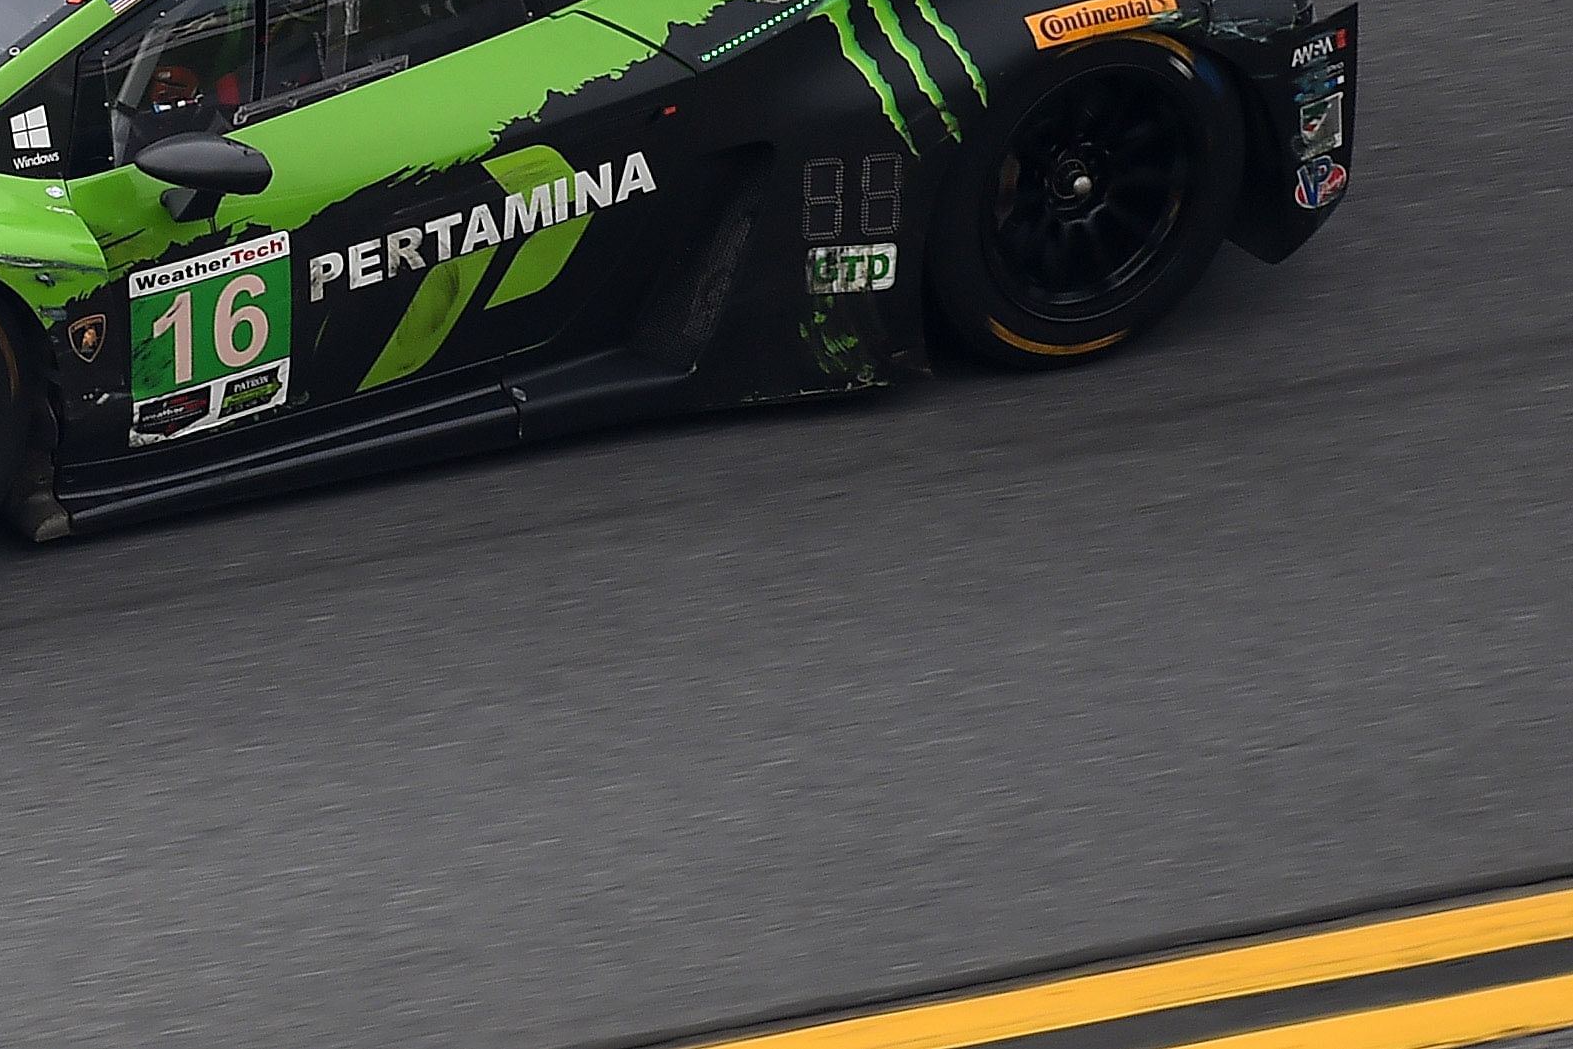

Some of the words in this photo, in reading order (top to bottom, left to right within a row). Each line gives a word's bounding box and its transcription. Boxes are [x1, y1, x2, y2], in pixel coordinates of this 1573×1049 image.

[13, 151, 60, 170] Windows
[309, 151, 658, 303] PERTAMINA
[135, 238, 285, 291] WeatherTech
[814, 253, 891, 283] GTD
[153, 273, 267, 385] 16
